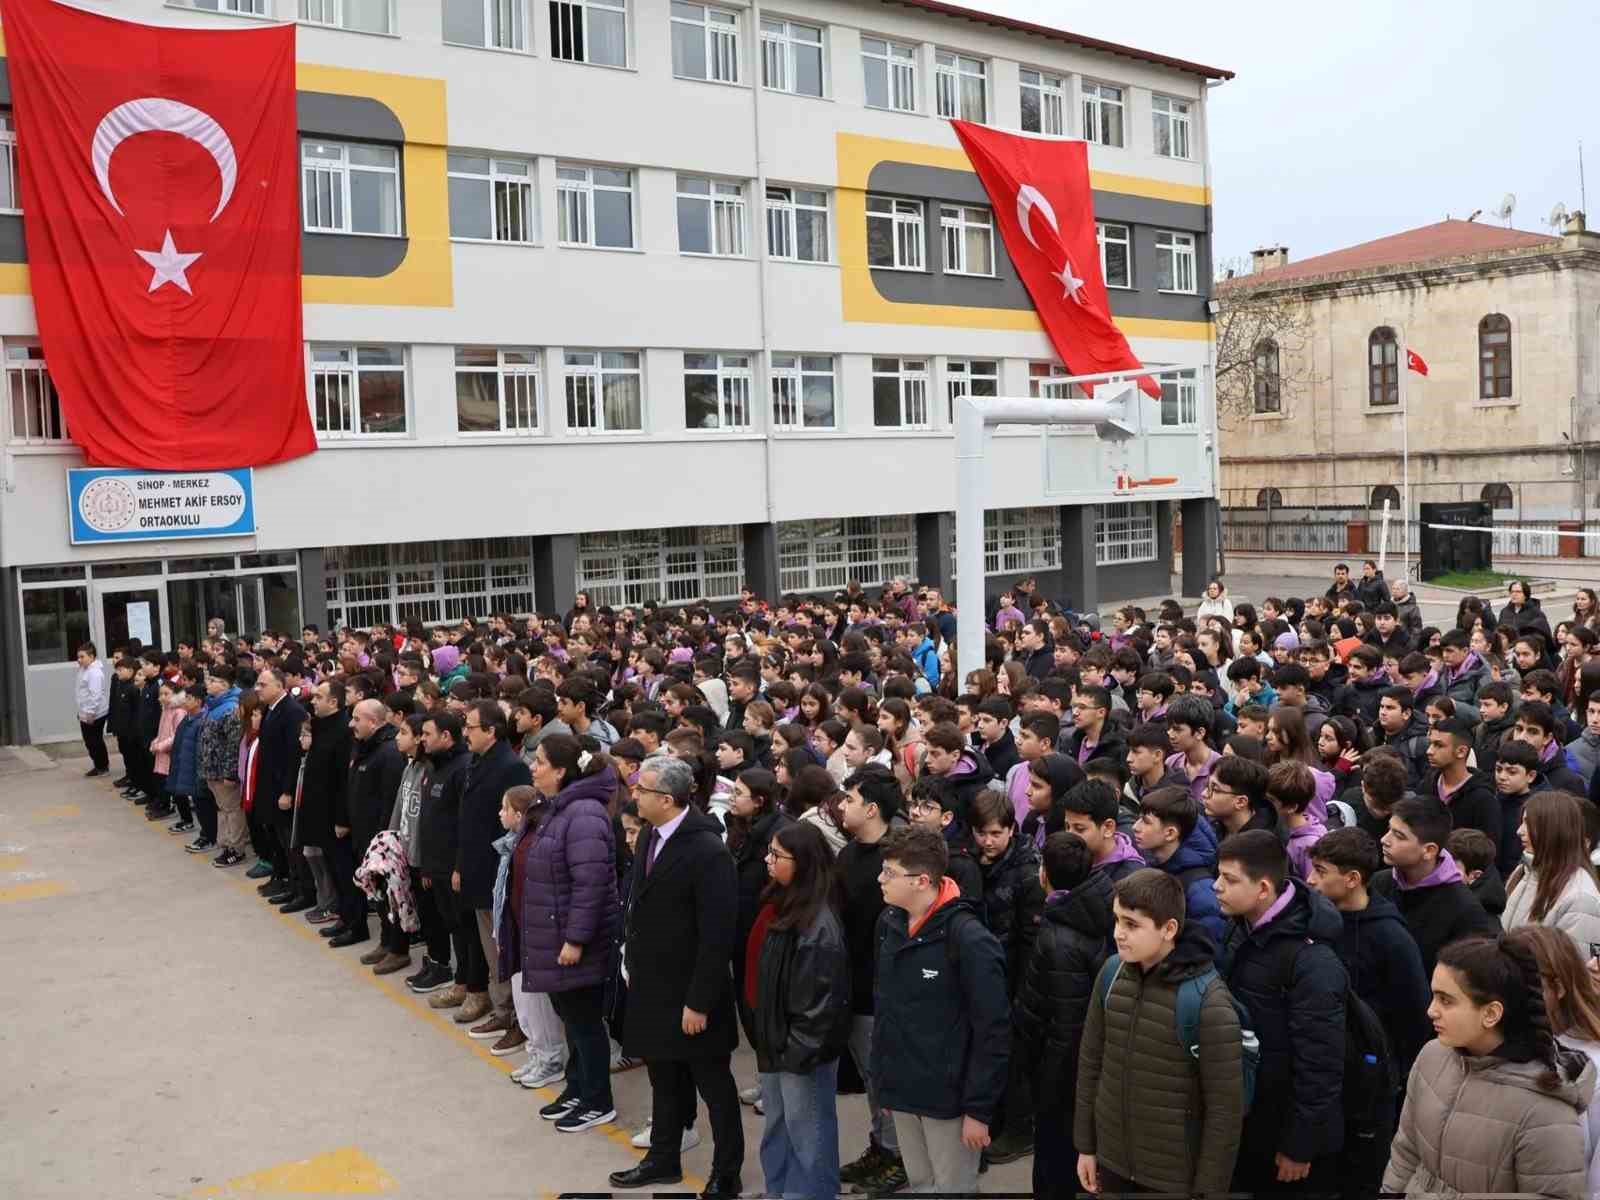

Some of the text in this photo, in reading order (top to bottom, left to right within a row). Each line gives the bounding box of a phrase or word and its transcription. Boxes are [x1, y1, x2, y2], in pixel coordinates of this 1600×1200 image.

[137, 480, 165, 490] SİNOP
[173, 479, 209, 489] MERKEZ
[138, 494, 242, 509] MEHMET AKİF ERSOY
[139, 514, 200, 528] ORTAOKULU
